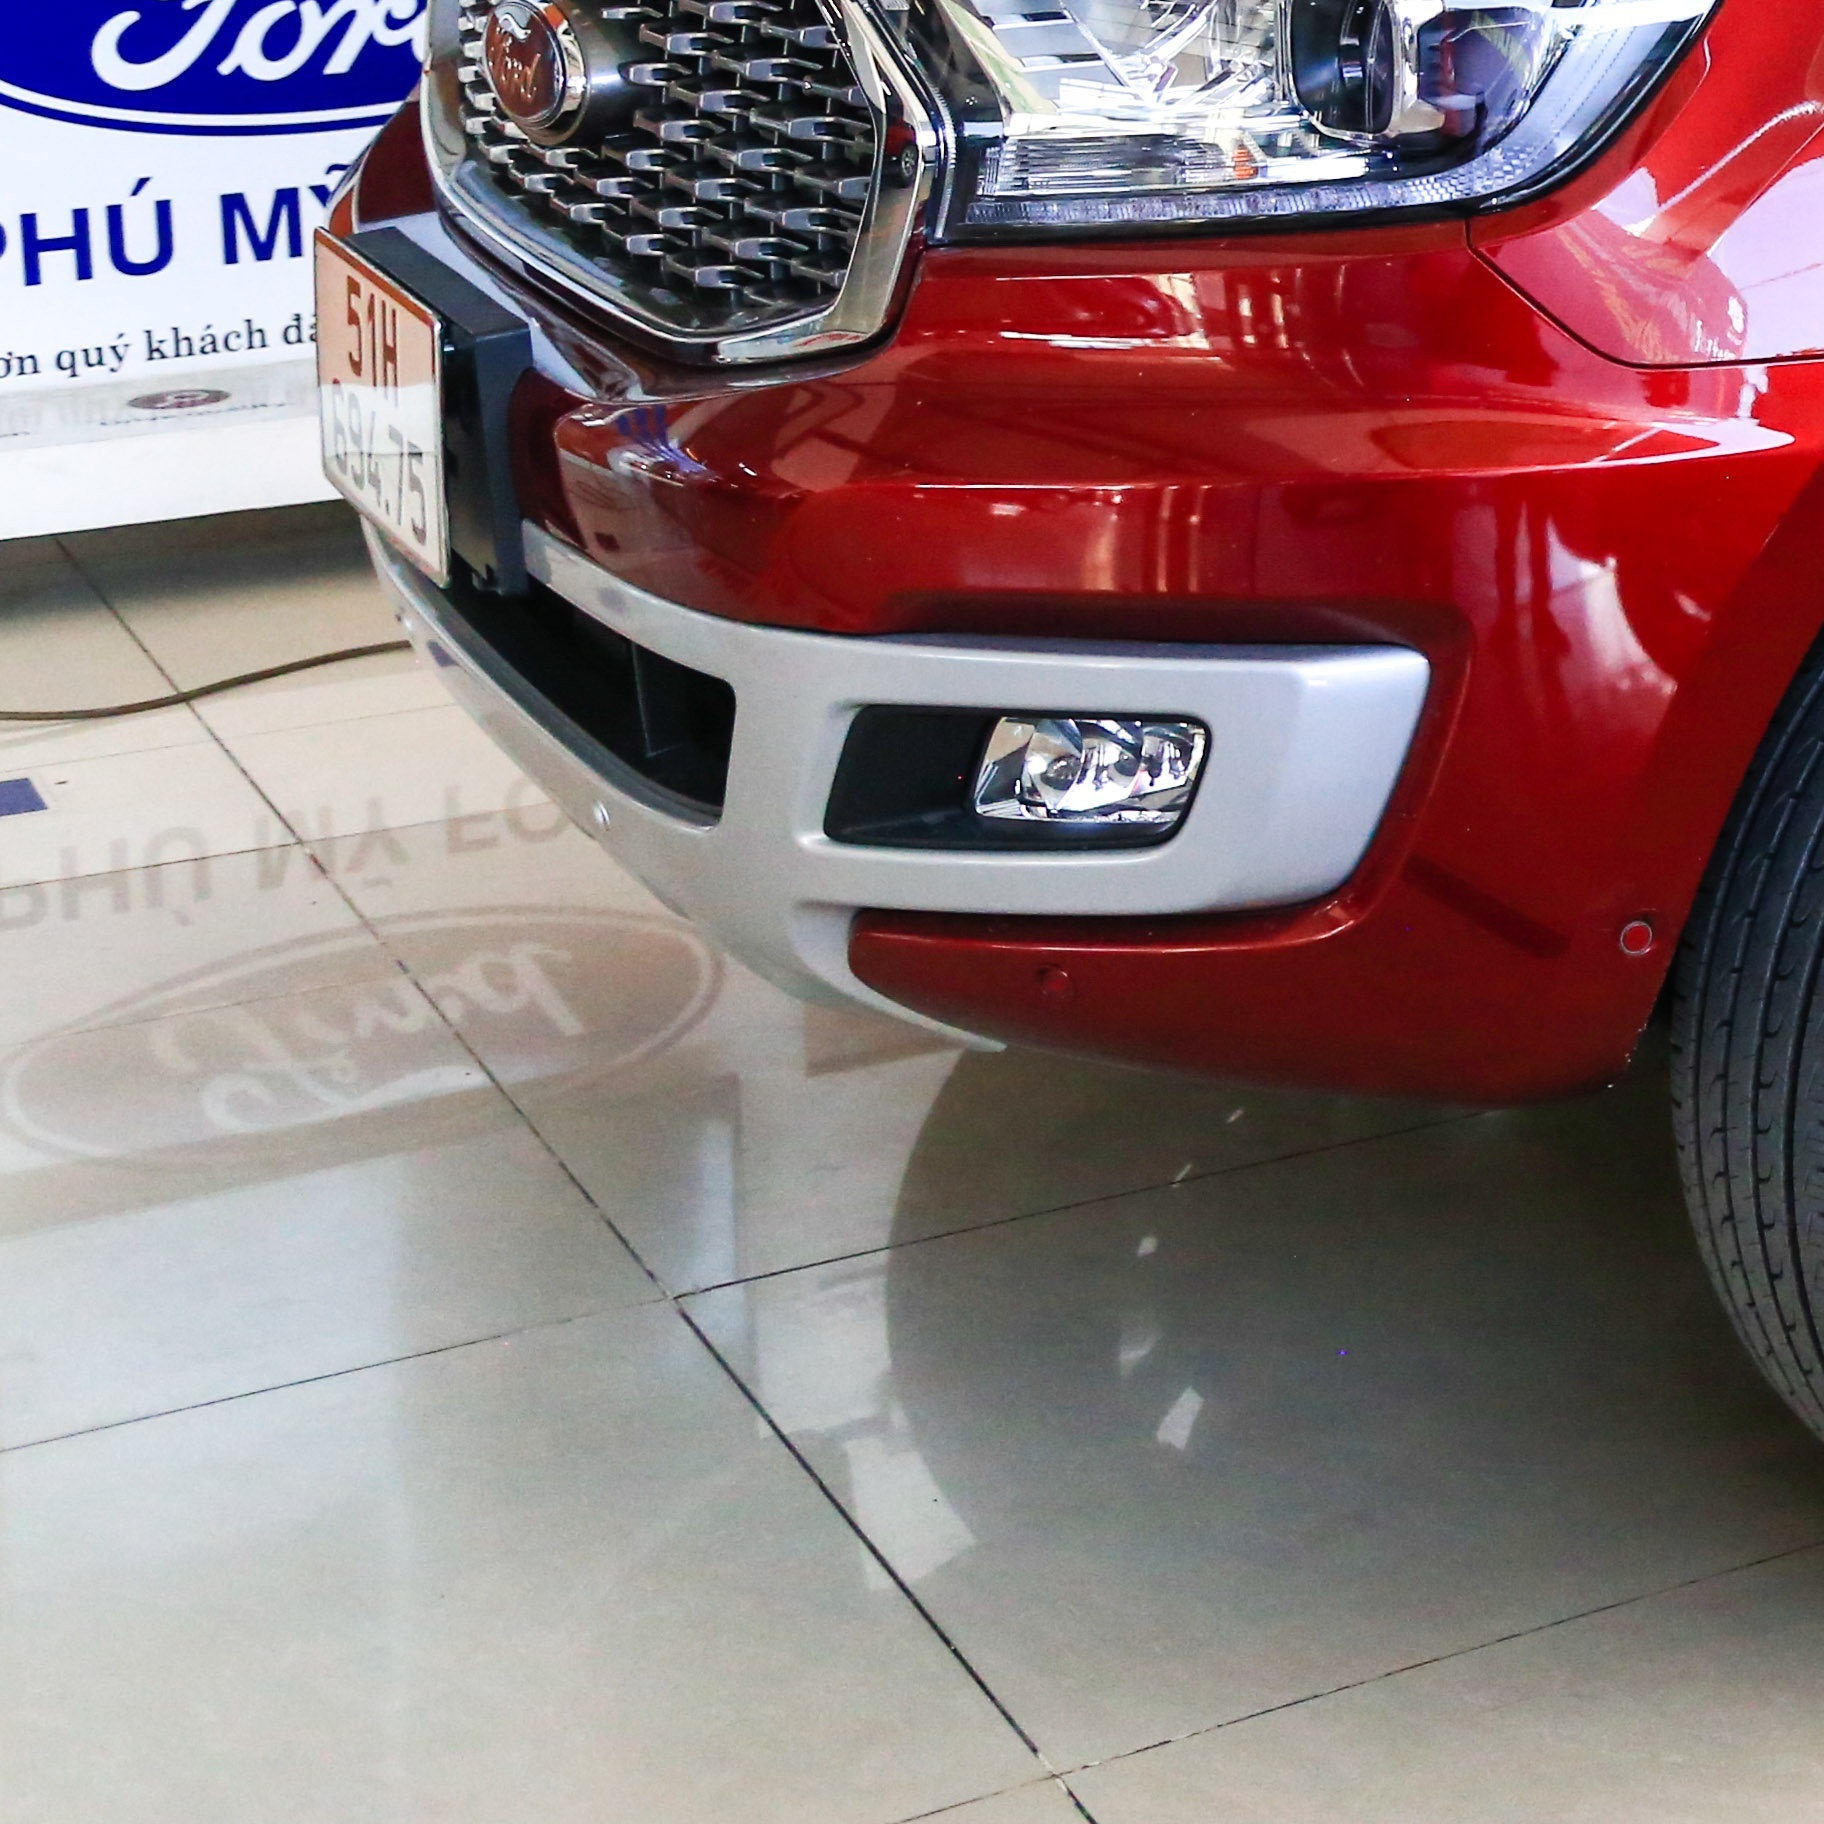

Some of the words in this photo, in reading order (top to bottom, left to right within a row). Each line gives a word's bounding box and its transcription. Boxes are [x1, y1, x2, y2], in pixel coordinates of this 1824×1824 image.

[0, 176, 174, 286] HÚ
[55, 333, 132, 378] quý
[144, 319, 269, 361] khách
[347, 275, 399, 408] 51H
[332, 378, 426, 546] 694.75
